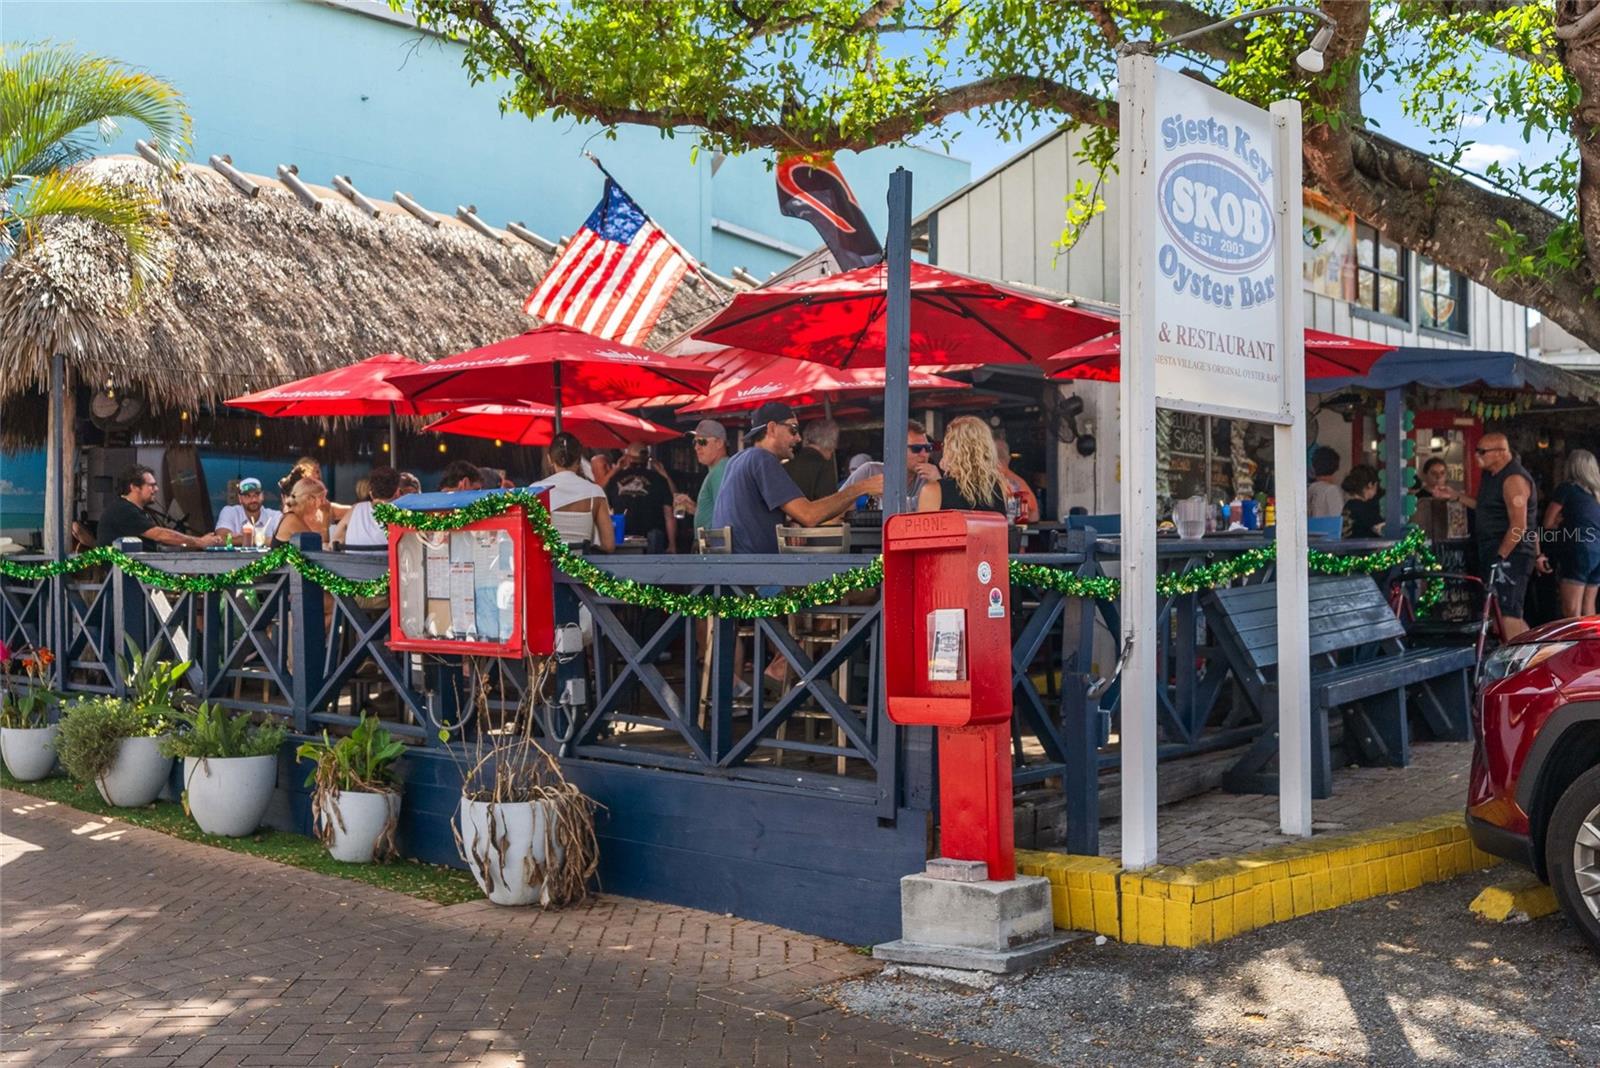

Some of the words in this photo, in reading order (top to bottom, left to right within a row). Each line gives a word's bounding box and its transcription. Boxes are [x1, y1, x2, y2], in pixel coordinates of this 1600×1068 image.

[1161, 114, 1229, 149] Siesta
[1235, 126, 1274, 184] Key
[1172, 176, 1264, 244] SKOB
[1194, 231, 1217, 252] EST.
[1220, 239, 1245, 257] 2003
[1159, 244, 1234, 307] Oyster
[1238, 275, 1275, 308] Bar
[1158, 322, 1171, 343] &
[1176, 324, 1275, 361] RESTAURANT
[904, 516, 949, 533] PHONE
